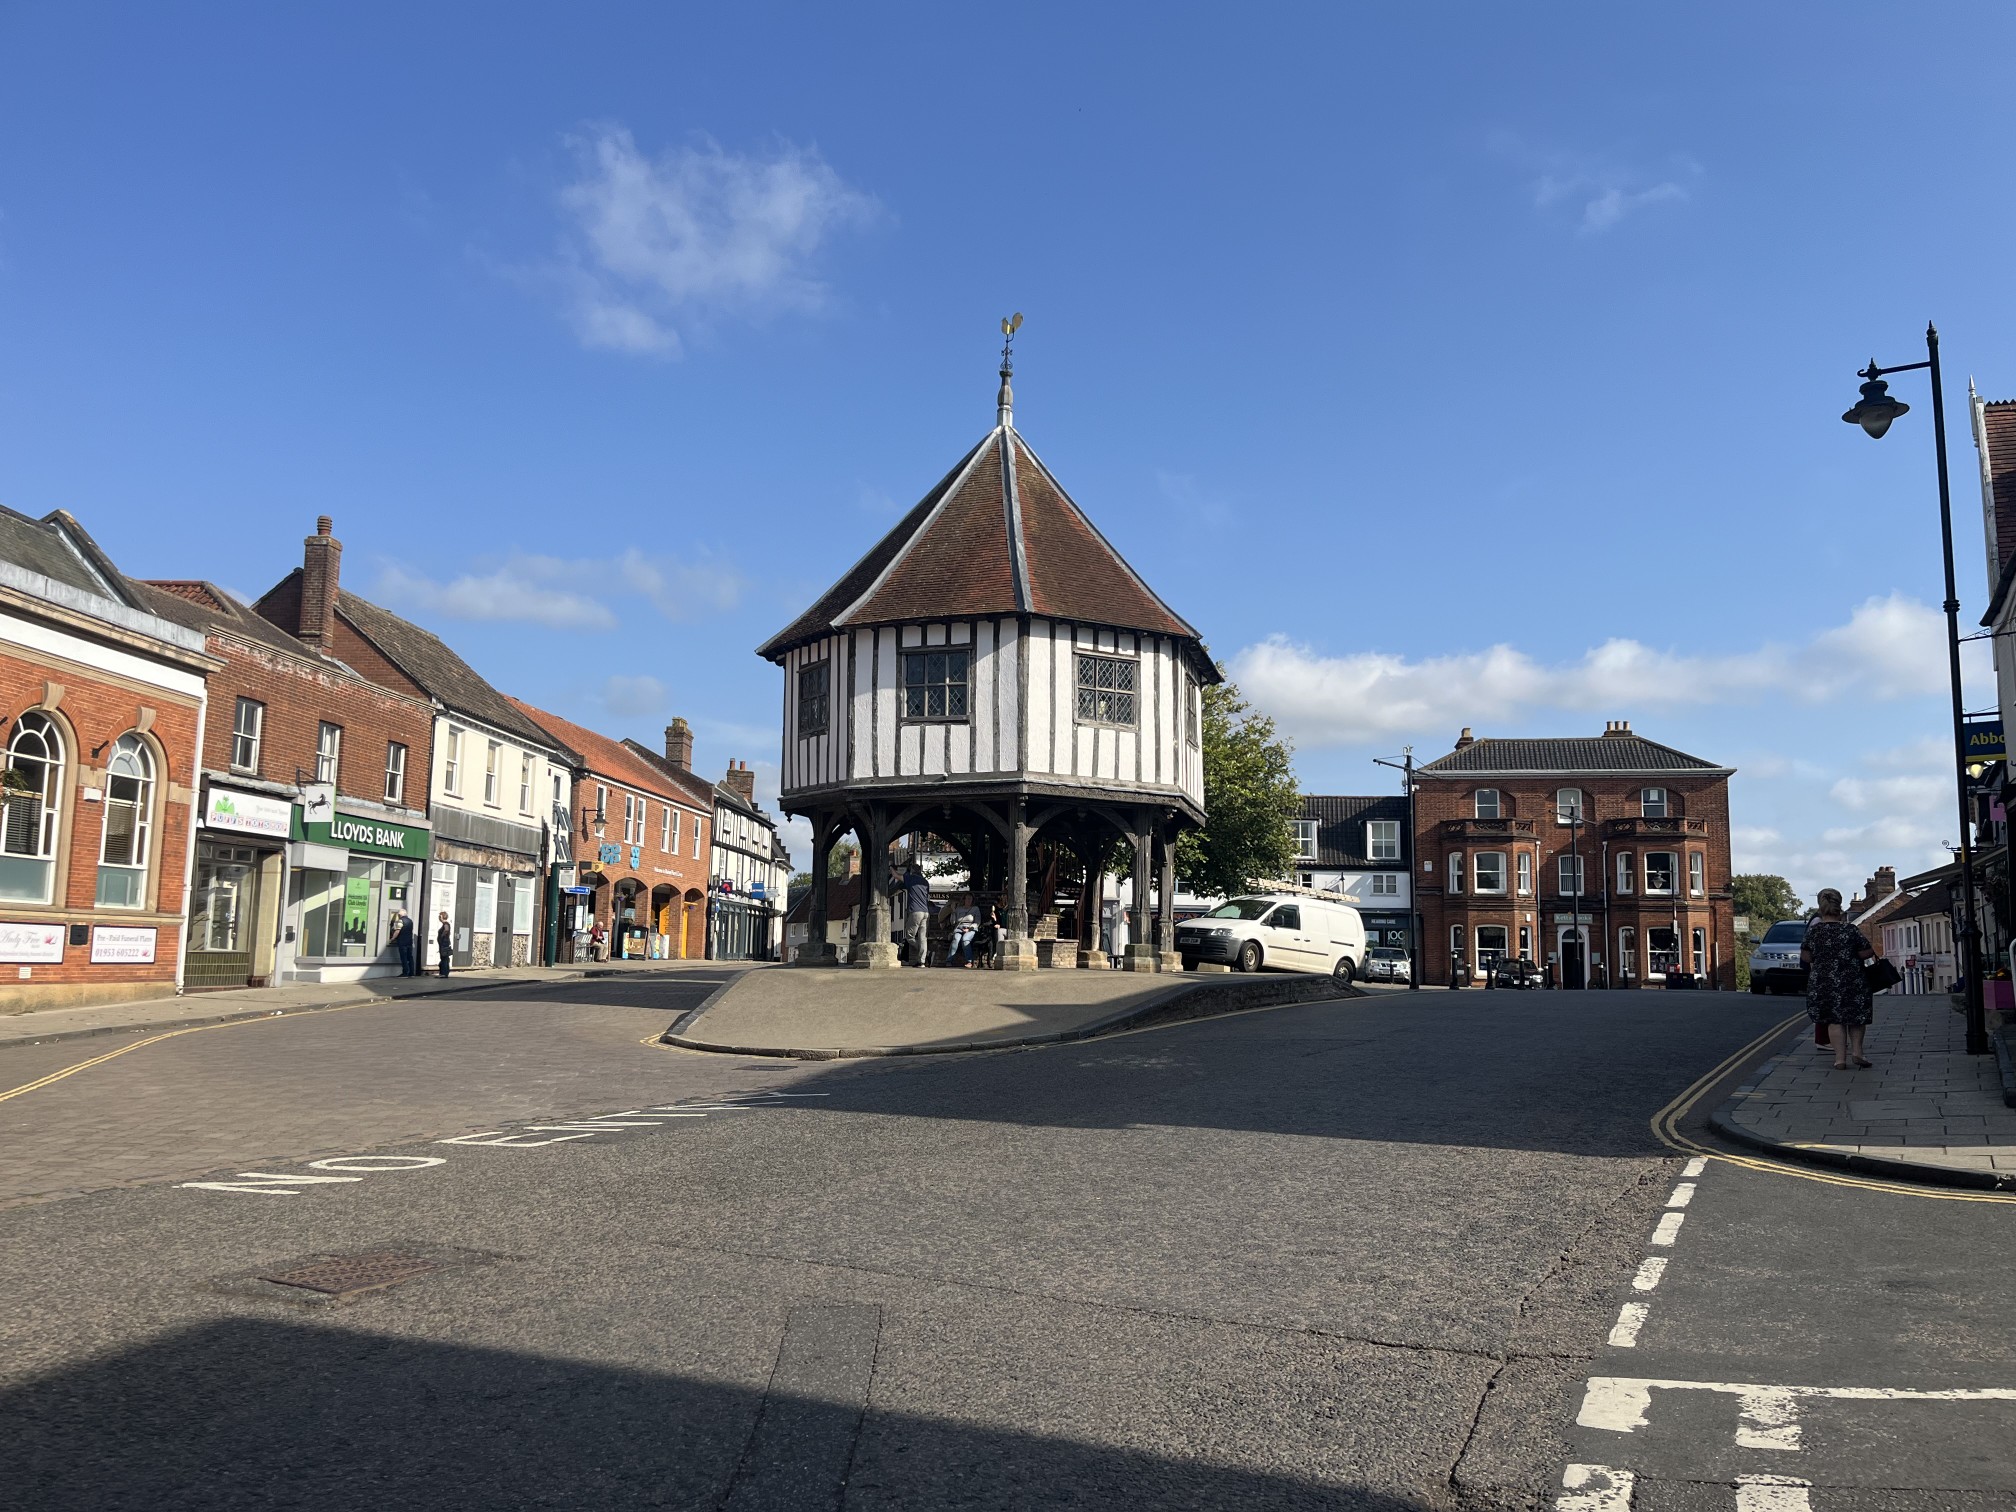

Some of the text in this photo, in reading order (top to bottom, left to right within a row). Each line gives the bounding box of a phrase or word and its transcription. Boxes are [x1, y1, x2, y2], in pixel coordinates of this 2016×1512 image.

[331, 821, 404, 849] LLOYDS BANK
[95, 948, 115, 957] 01953
[174, 1155, 446, 1195] NO
